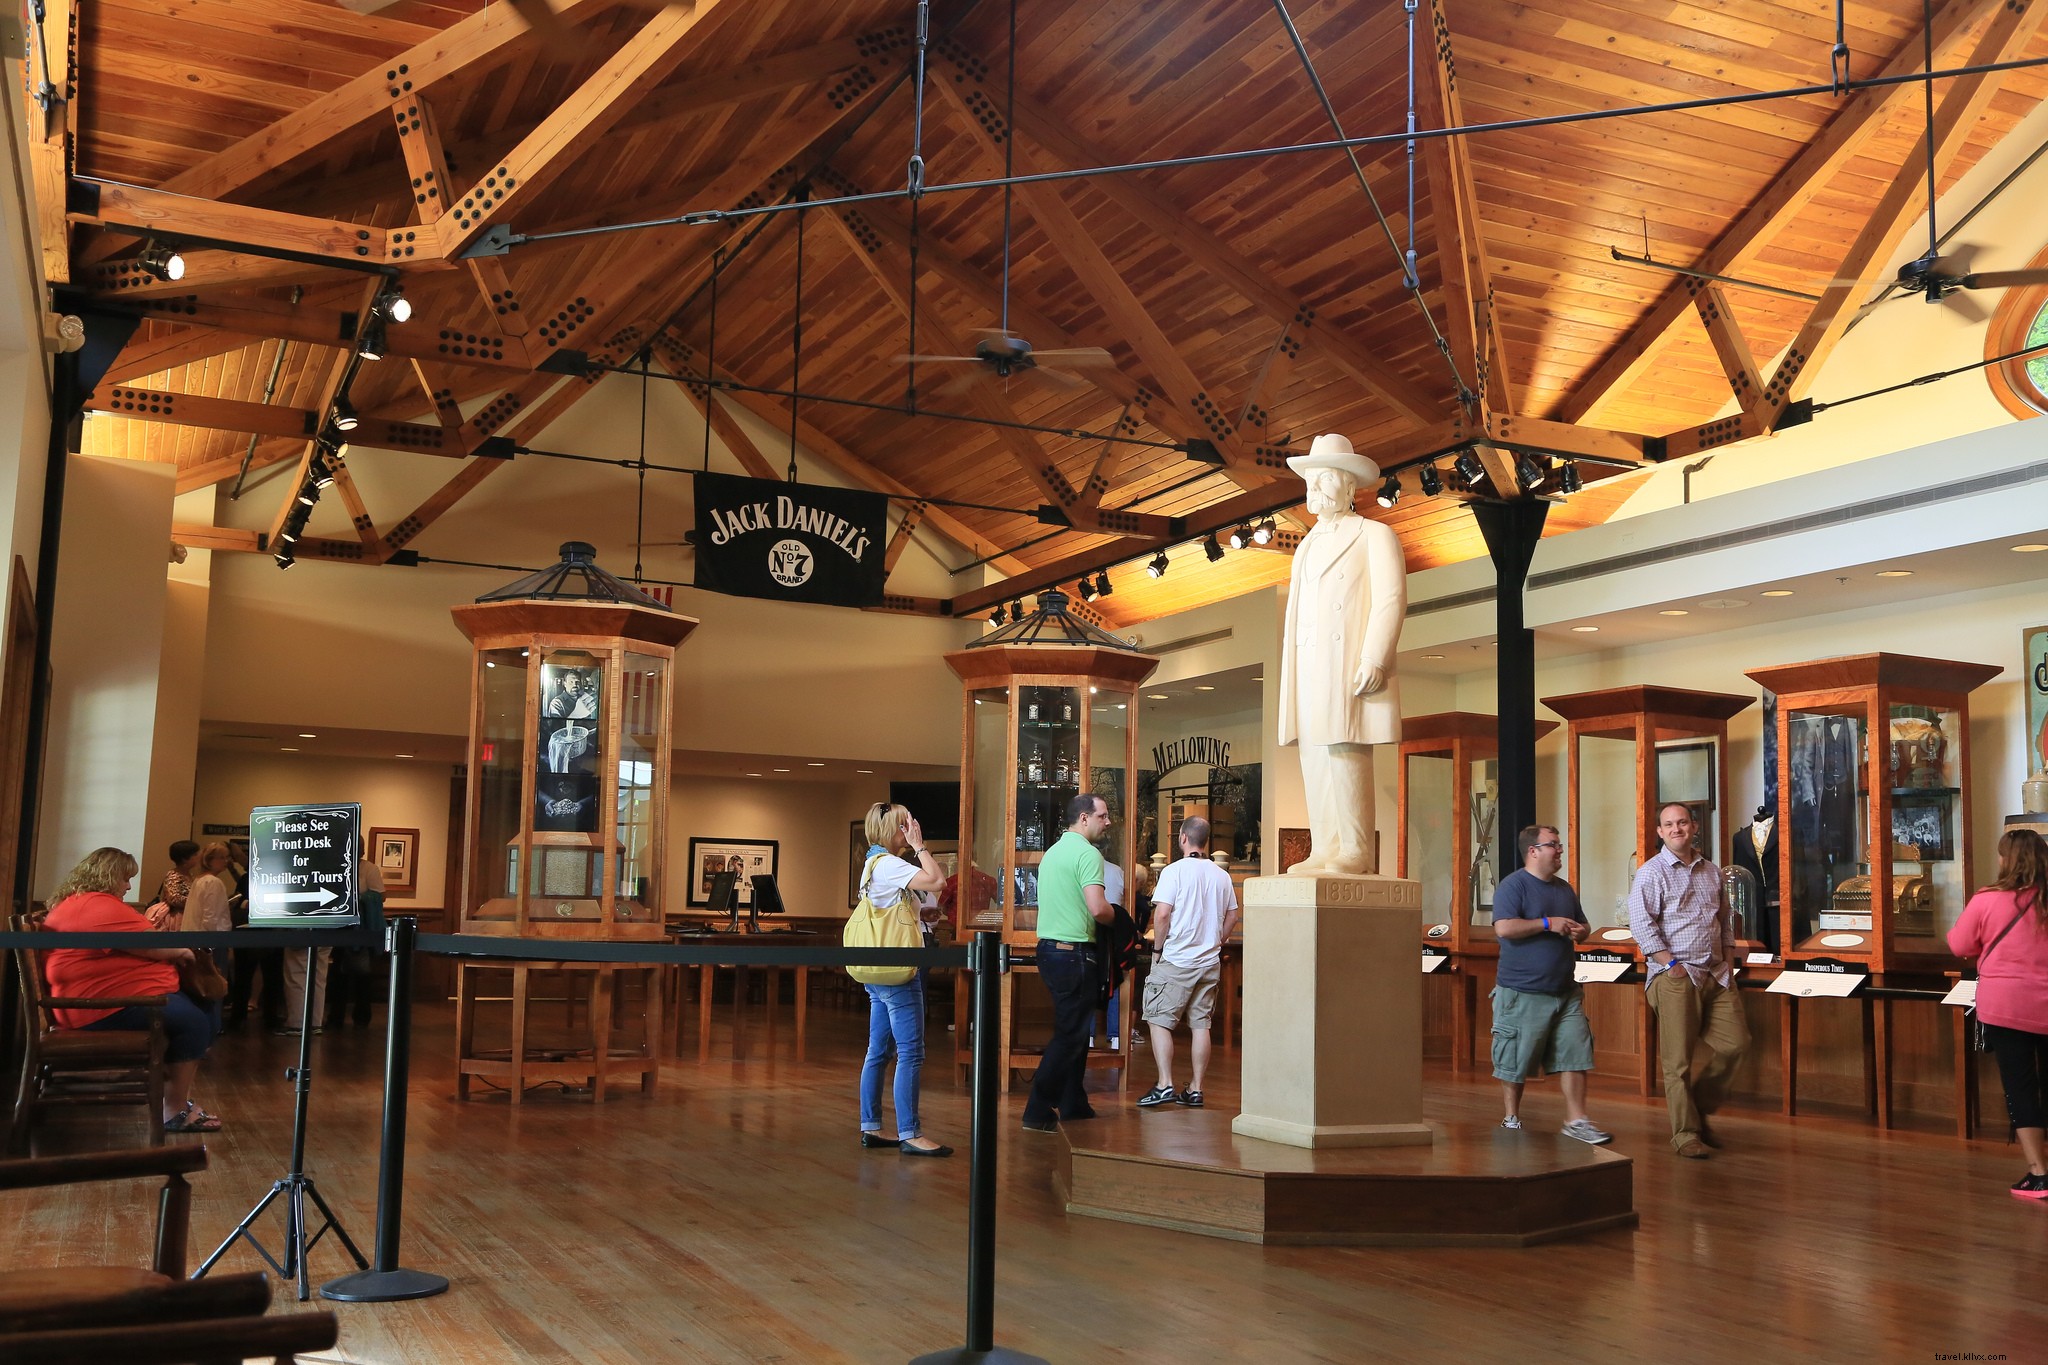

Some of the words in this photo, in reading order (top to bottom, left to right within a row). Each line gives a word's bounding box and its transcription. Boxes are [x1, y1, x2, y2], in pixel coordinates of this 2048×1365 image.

[710, 502, 772, 545] JACK
[777, 496, 871, 560] DANIEL'S
[781, 543, 800, 552] OLD
[776, 573, 803, 584] BRAND
[1152, 736, 1230, 776] MELLOWING
[274, 820, 308, 834] Please
[310, 818, 329, 831] See
[272, 838, 302, 851] Front
[304, 836, 332, 849] Desk
[292, 854, 310, 867] for
[260, 871, 309, 887] Distillery
[311, 870, 343, 884] Tours
[1805, 962, 1830, 972] PROSPEROUS
[1831, 964, 1844, 973] TIMES
